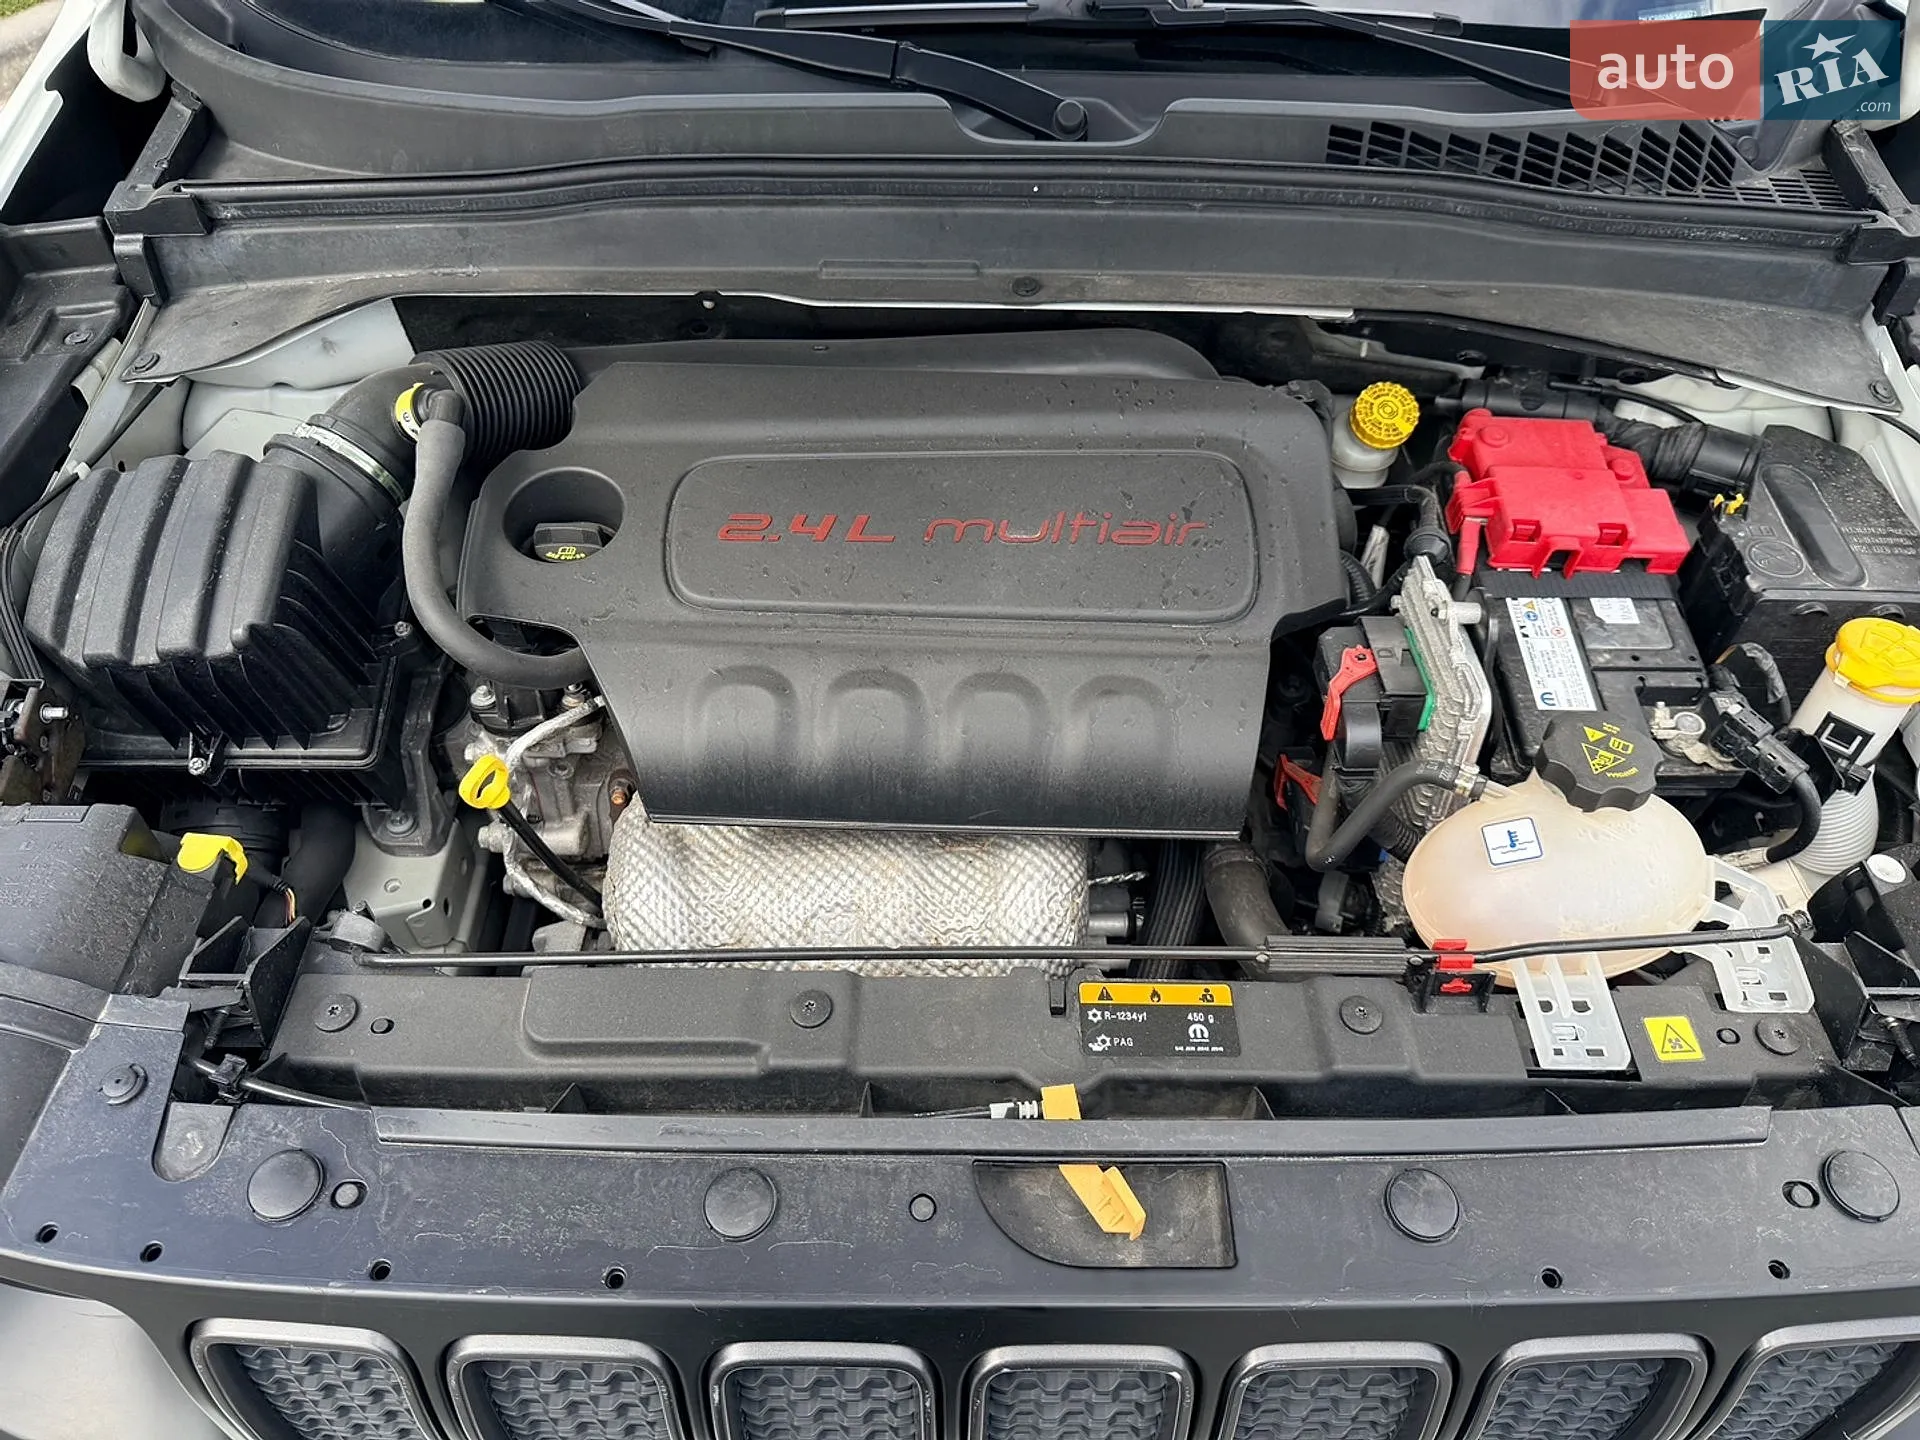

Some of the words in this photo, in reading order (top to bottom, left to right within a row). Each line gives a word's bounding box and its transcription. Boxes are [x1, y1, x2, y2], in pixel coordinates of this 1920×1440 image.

[717, 513, 896, 543] 2.4L
[923, 511, 1207, 546] multiair
[1187, 1012, 1204, 1022] 450
[1113, 1037, 1133, 1047] PAG
